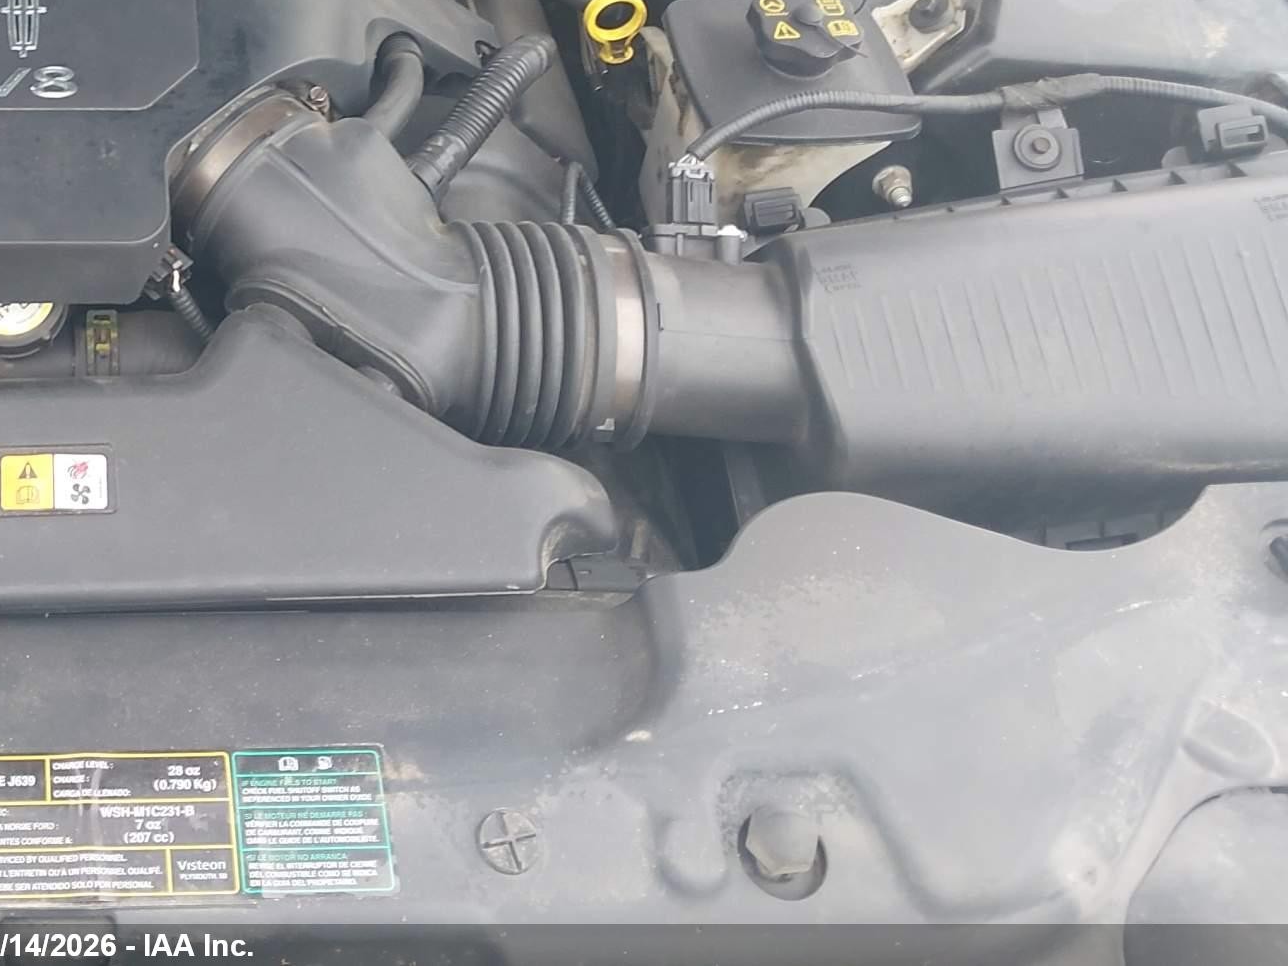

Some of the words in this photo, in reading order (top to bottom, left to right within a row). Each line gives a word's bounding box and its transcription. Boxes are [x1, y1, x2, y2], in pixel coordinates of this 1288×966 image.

[53, 761, 84, 770] CHARGE
[168, 765, 184, 777] 28
[185, 766, 201, 776] oz
[7, 775, 36, 787] J639
[153, 778, 192, 792] (0.790
[193, 778, 217, 792] Kg)
[100, 805, 195, 818] WSH-M1C231-B
[134, 818, 144, 830] 7
[145, 820, 162, 830] oz
[123, 832, 152, 844] (207
[153, 831, 175, 843] cc)
[26, 855, 37, 863] BY
[38, 854, 79, 863] QUALIFIED
[177, 860, 226, 871] Visteon
[15, 883, 31, 891] SER
[72, 881, 94, 890] SOLO
